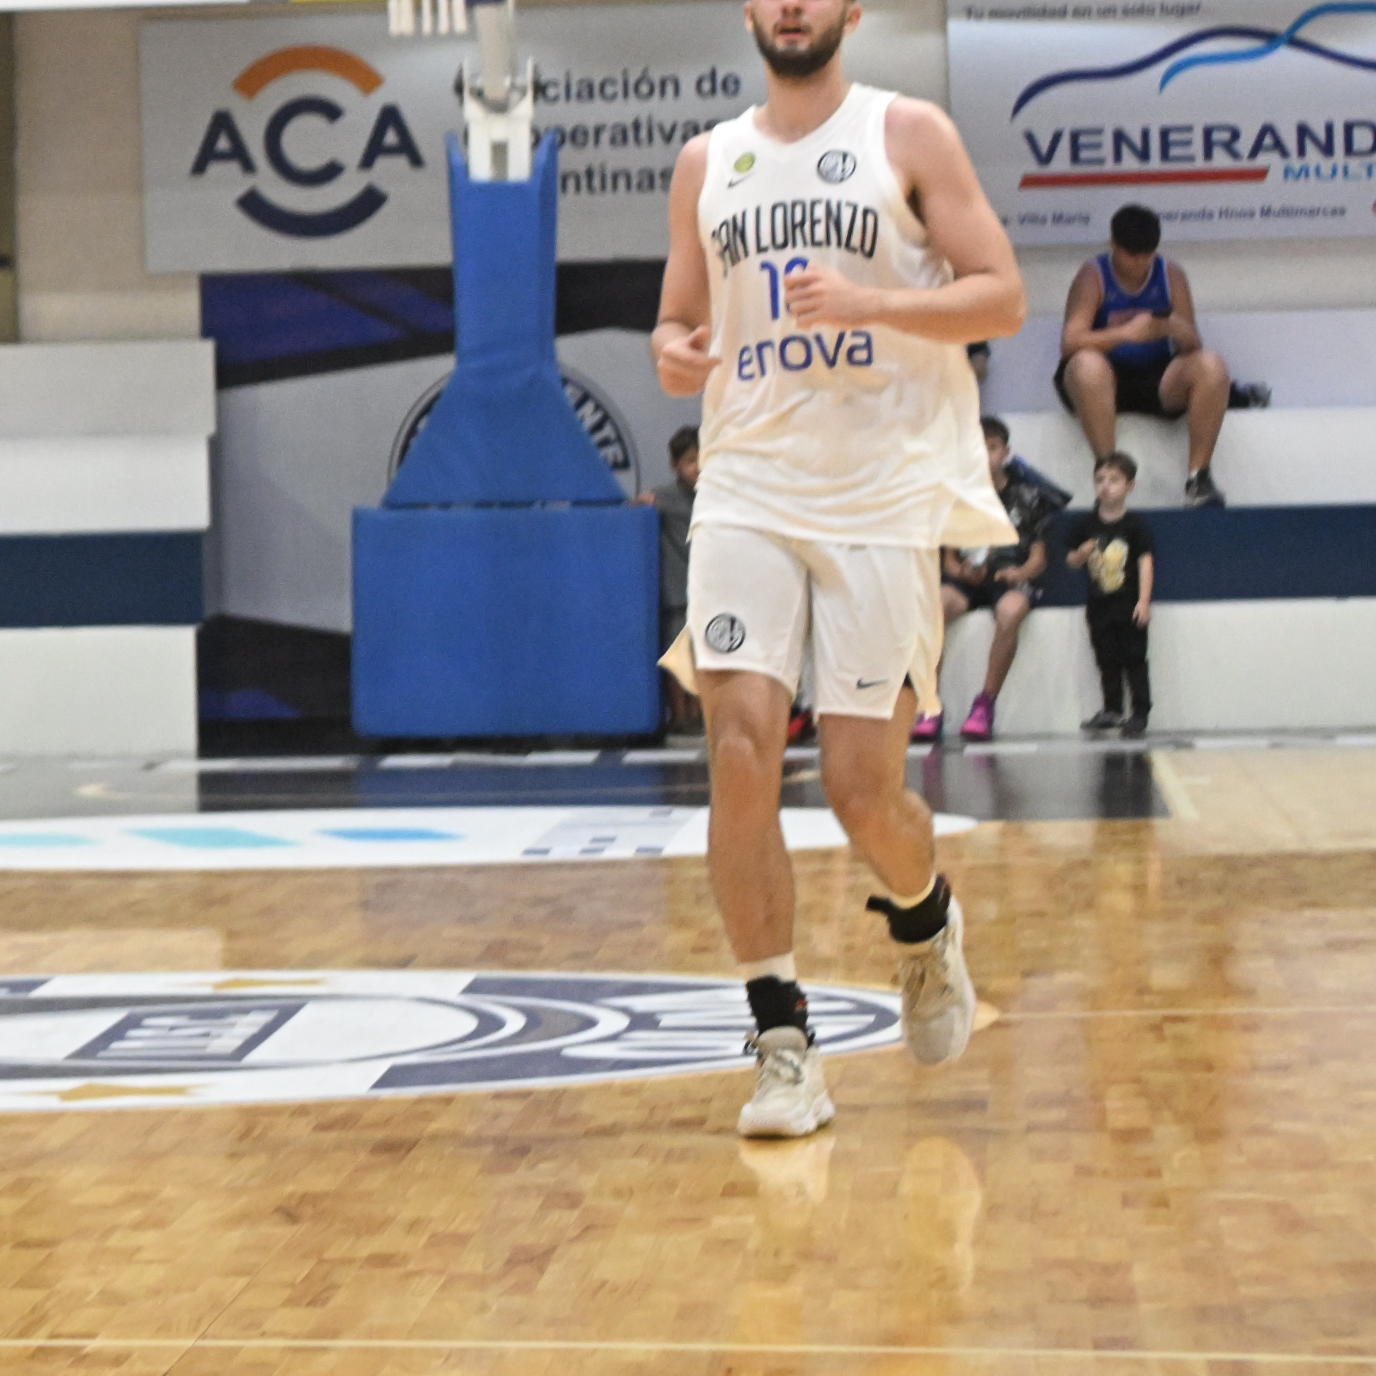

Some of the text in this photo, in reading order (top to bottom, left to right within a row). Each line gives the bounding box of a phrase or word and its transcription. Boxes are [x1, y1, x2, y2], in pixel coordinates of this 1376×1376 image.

[695, 67, 743, 99] de
[190, 95, 425, 188] ACA
[755, 198, 879, 260] LORENZO
